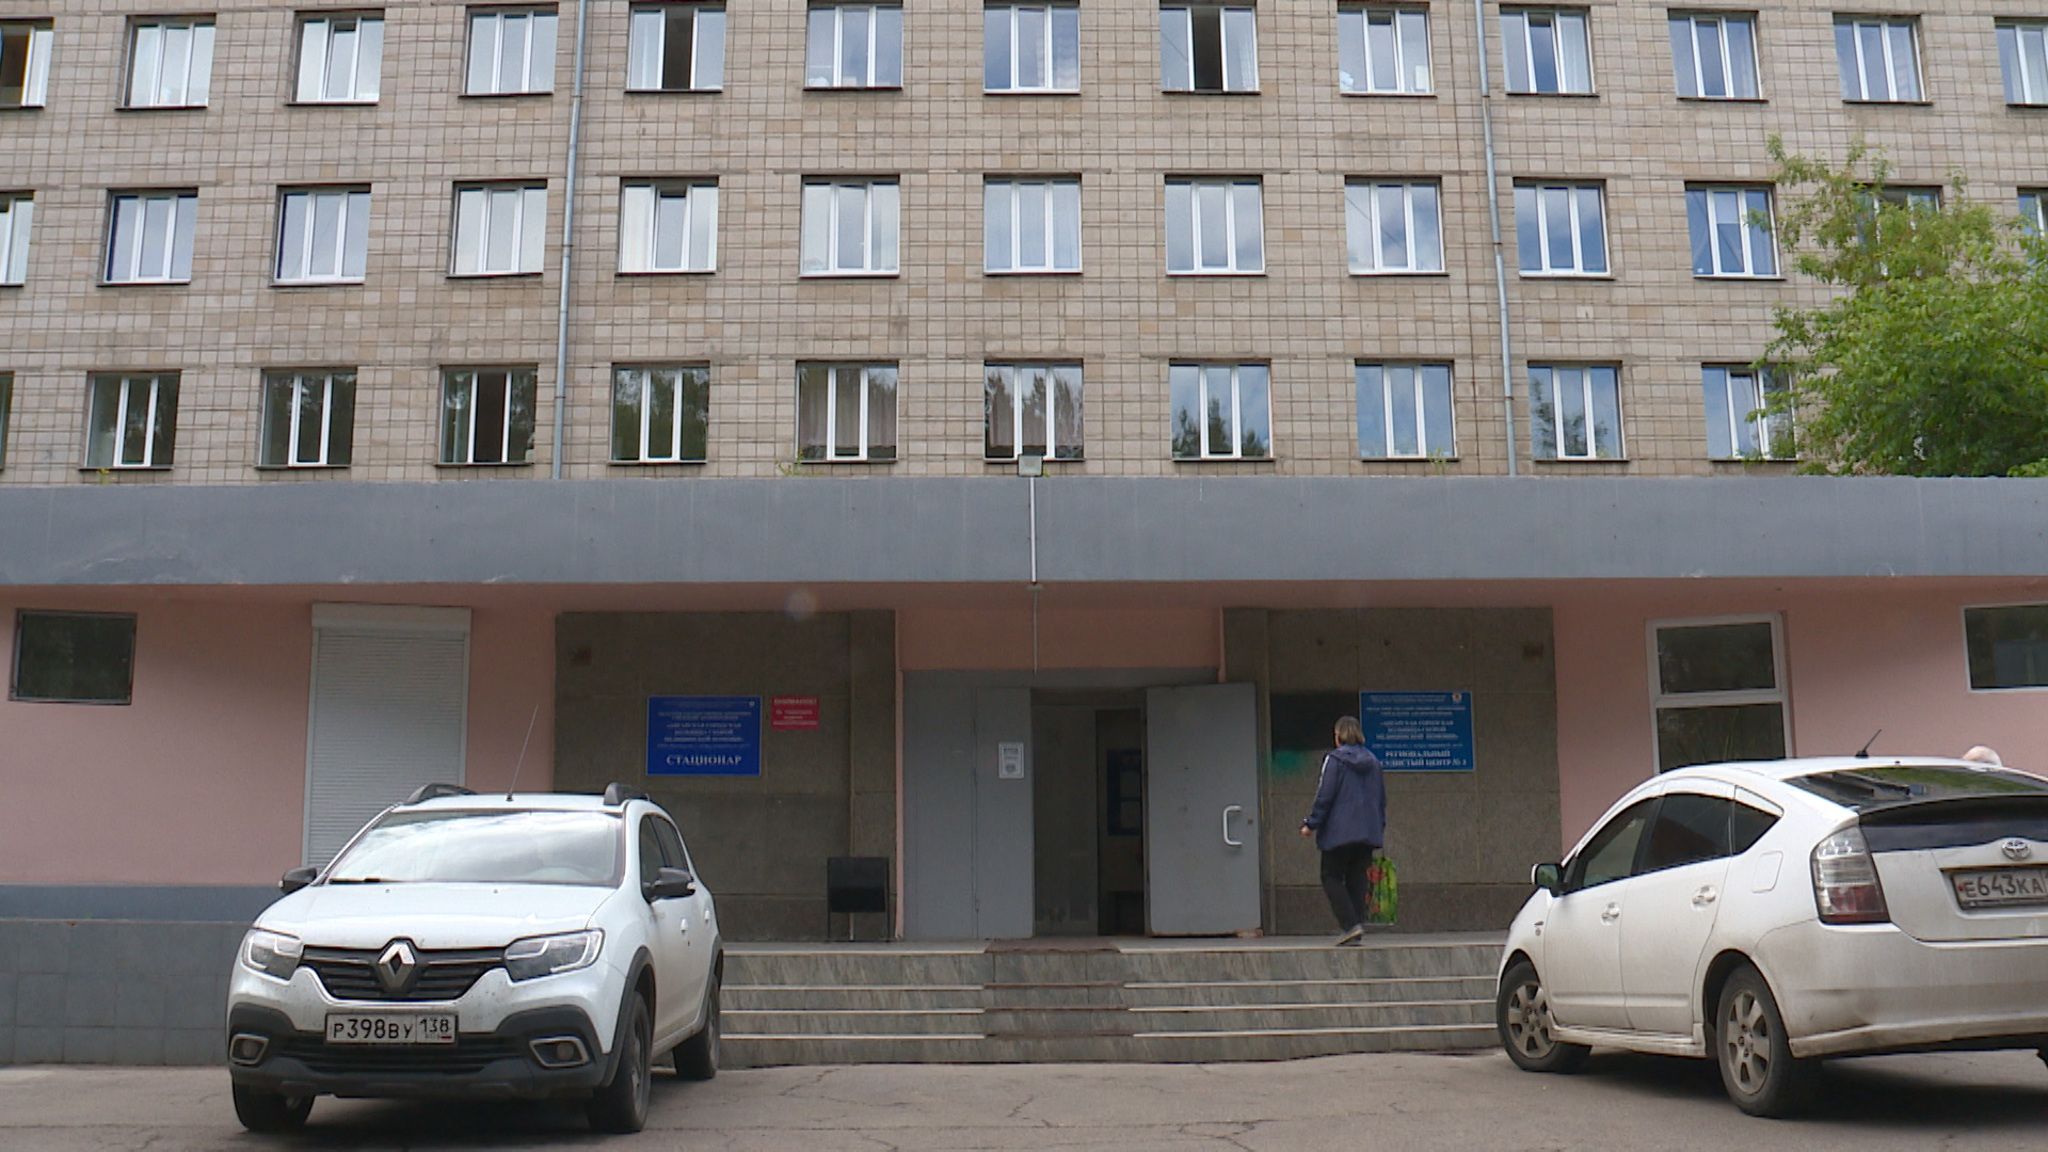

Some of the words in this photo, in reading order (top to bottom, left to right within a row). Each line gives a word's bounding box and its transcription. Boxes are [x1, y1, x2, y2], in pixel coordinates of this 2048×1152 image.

[666, 754, 742, 766] СТАЦИОНАР
[1964, 873, 2044, 898] Е643КА
[333, 1018, 413, 1039] Р398ВУ
[420, 1018, 450, 1033] 138
